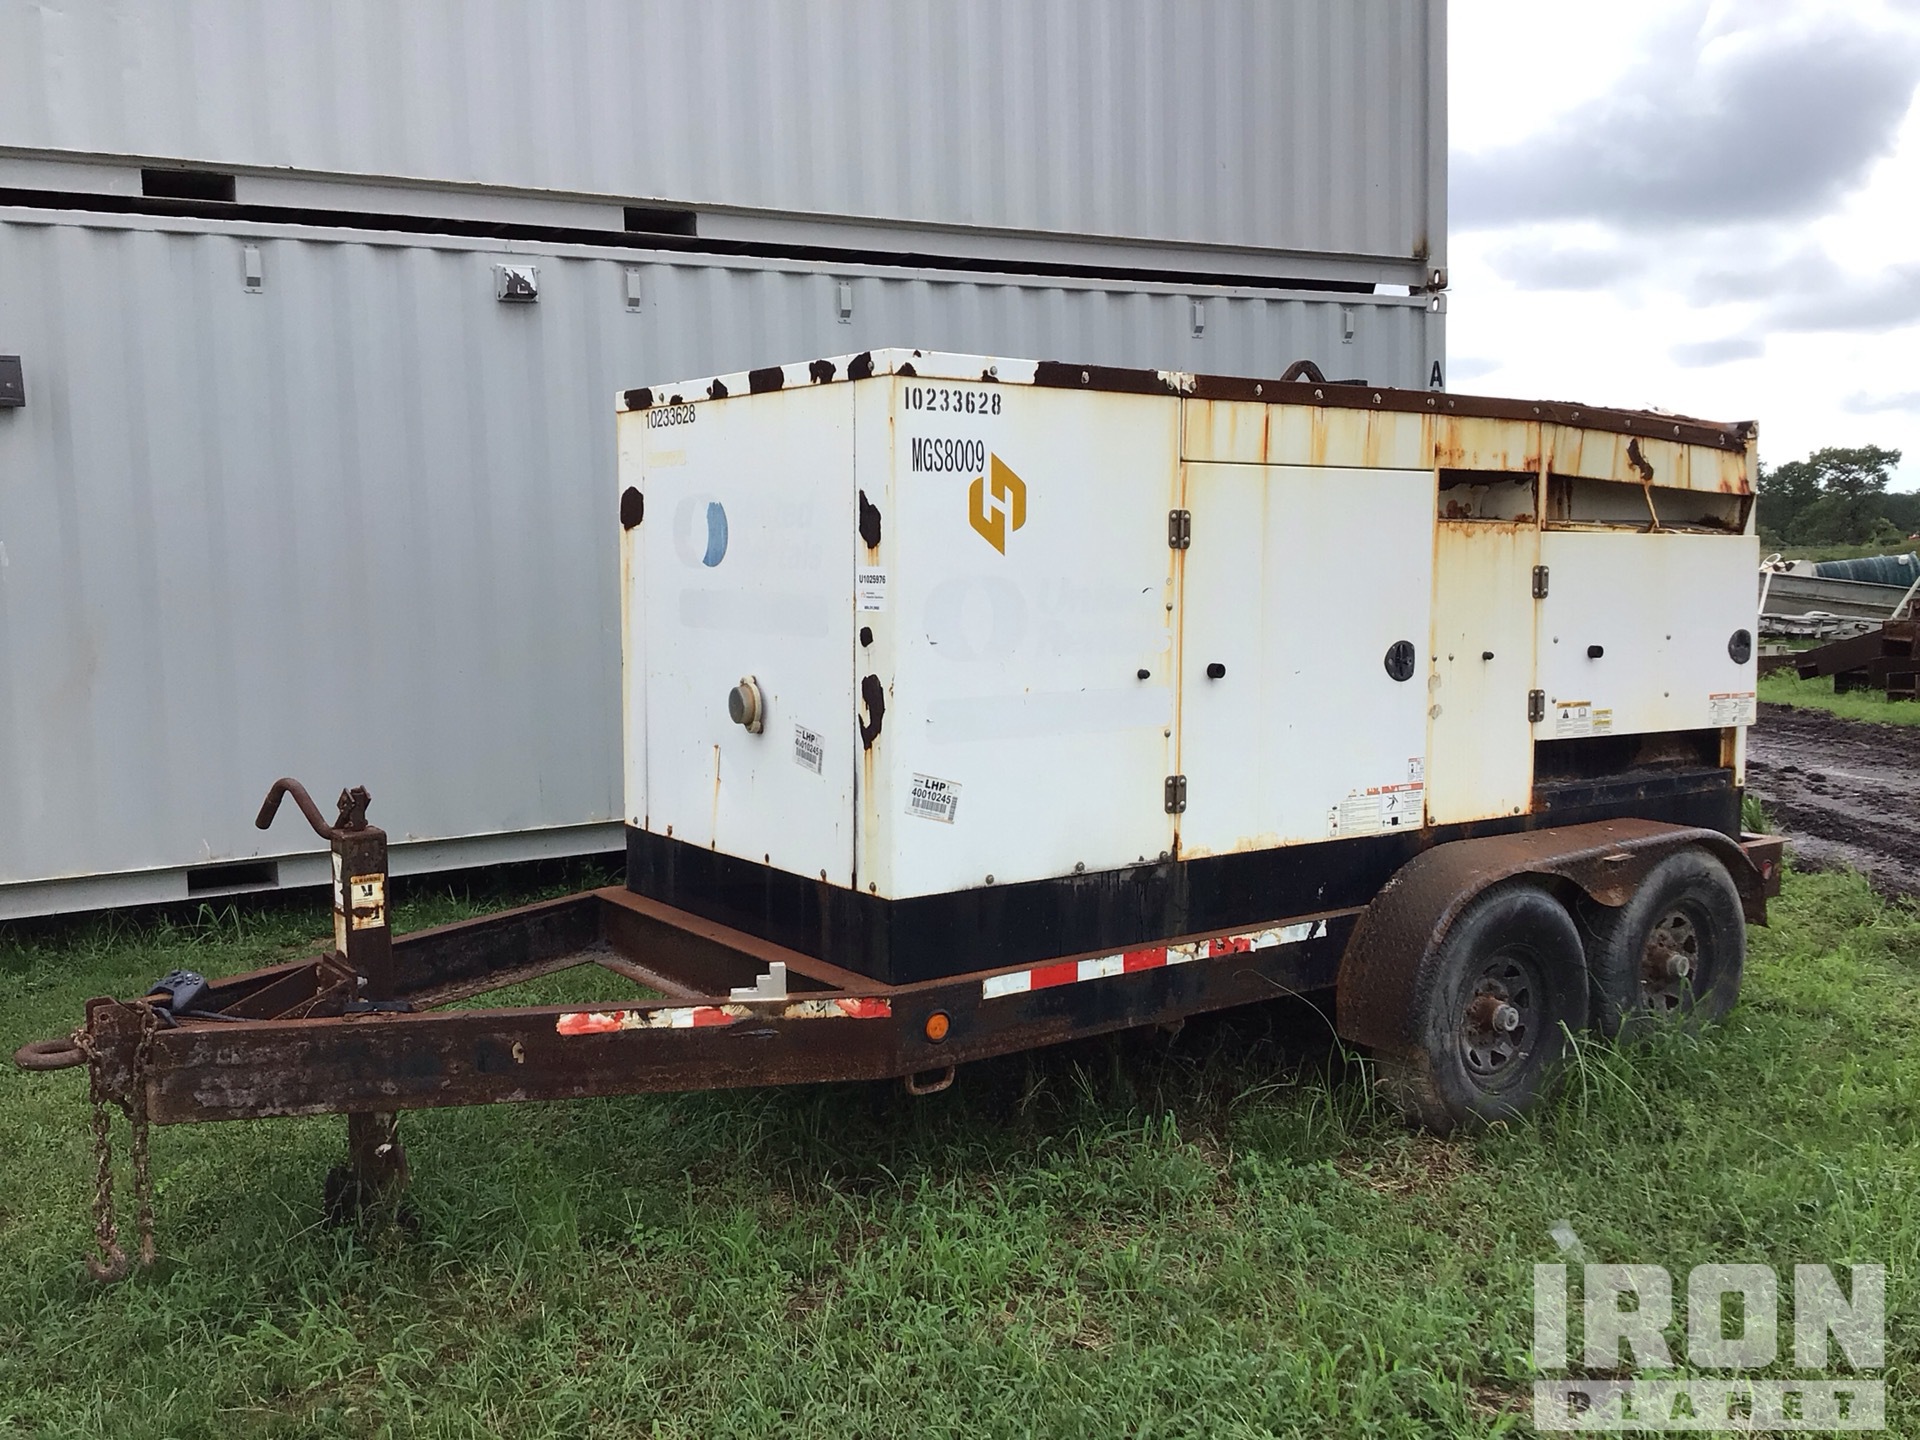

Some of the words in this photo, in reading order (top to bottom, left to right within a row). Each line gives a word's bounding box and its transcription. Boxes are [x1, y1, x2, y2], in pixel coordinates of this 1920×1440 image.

[1429, 360, 1443, 387] A
[904, 386, 1002, 415] 10233628
[645, 404, 696, 429] 10233628
[912, 437, 985, 472] MGS8009
[802, 730, 815, 743] LHP
[911, 787, 952, 805] 40010245
[924, 778, 947, 792] LHP
